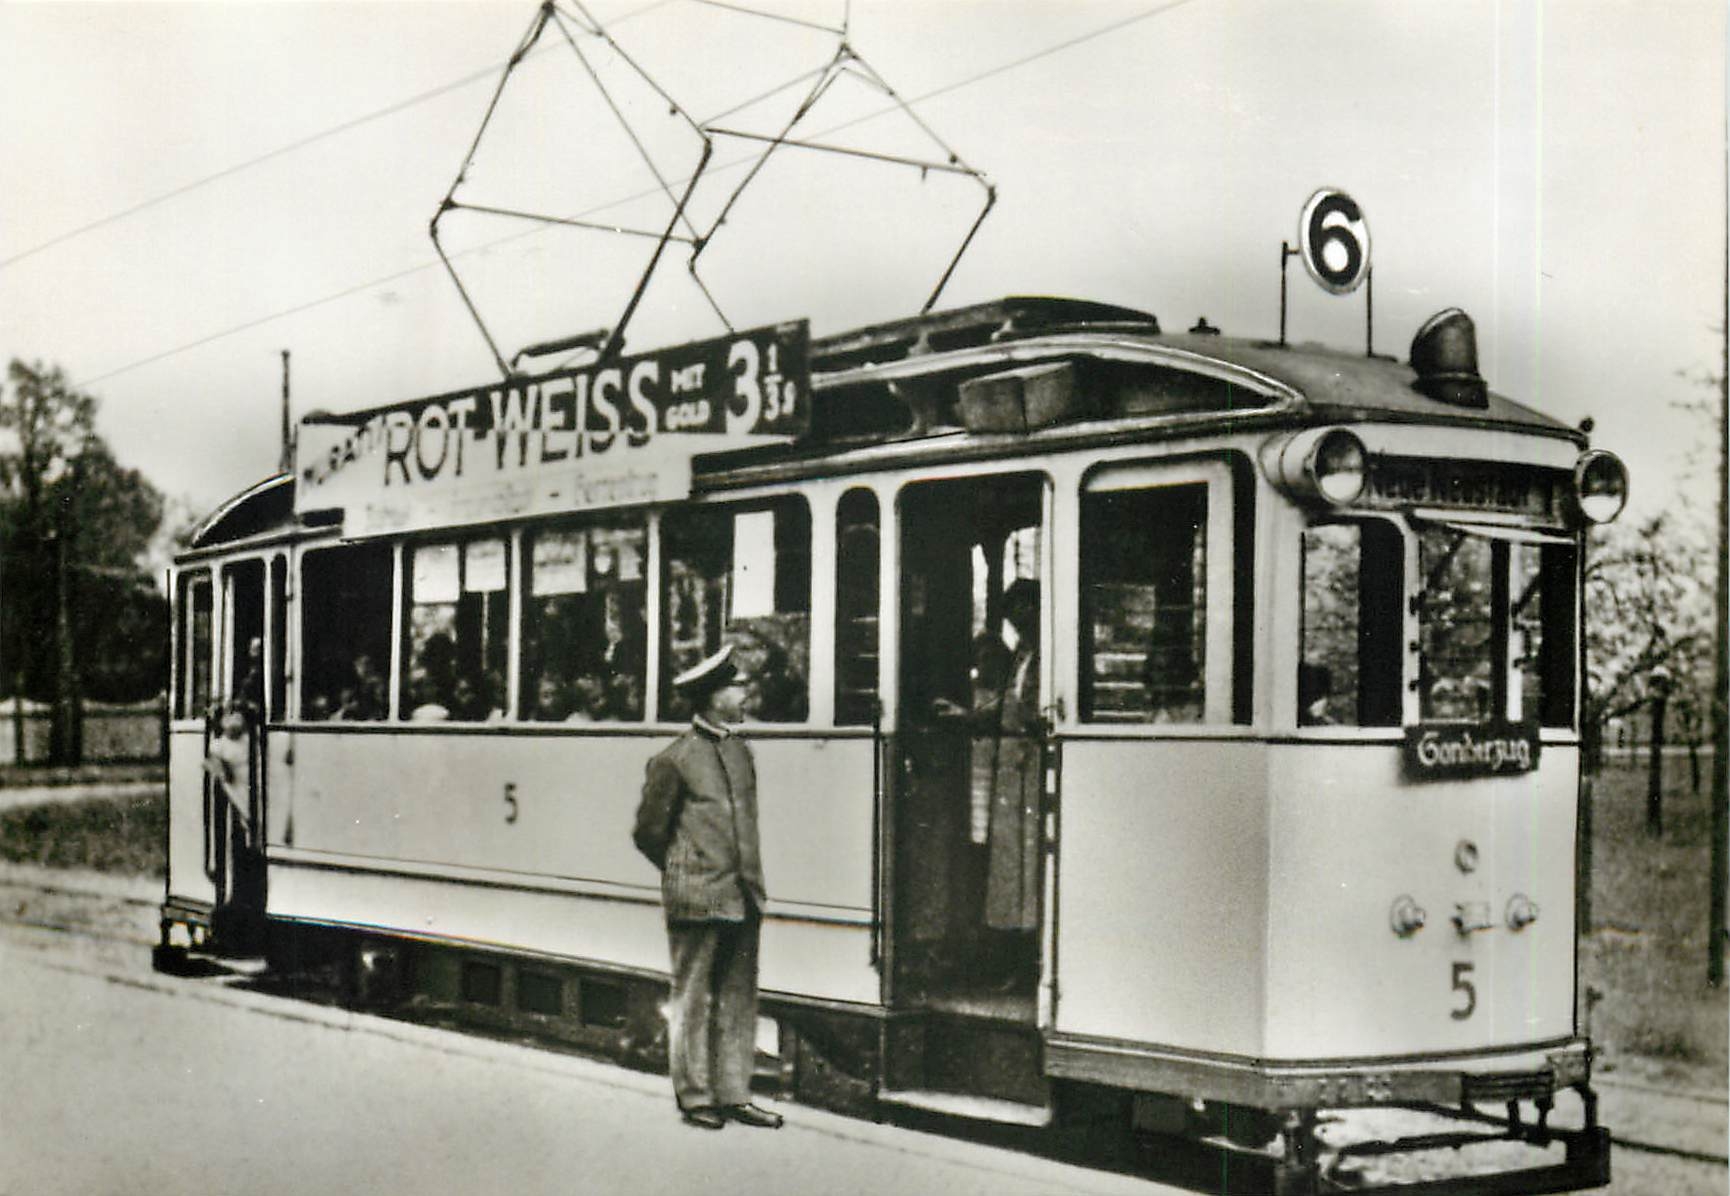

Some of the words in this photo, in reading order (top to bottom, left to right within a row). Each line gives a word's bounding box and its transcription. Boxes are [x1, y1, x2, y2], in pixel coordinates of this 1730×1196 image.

[1308, 192, 1362, 286] 6
[383, 359, 660, 488] ROT-WEISS
[504, 782, 519, 826] 5
[1450, 961, 1477, 1021] 5
